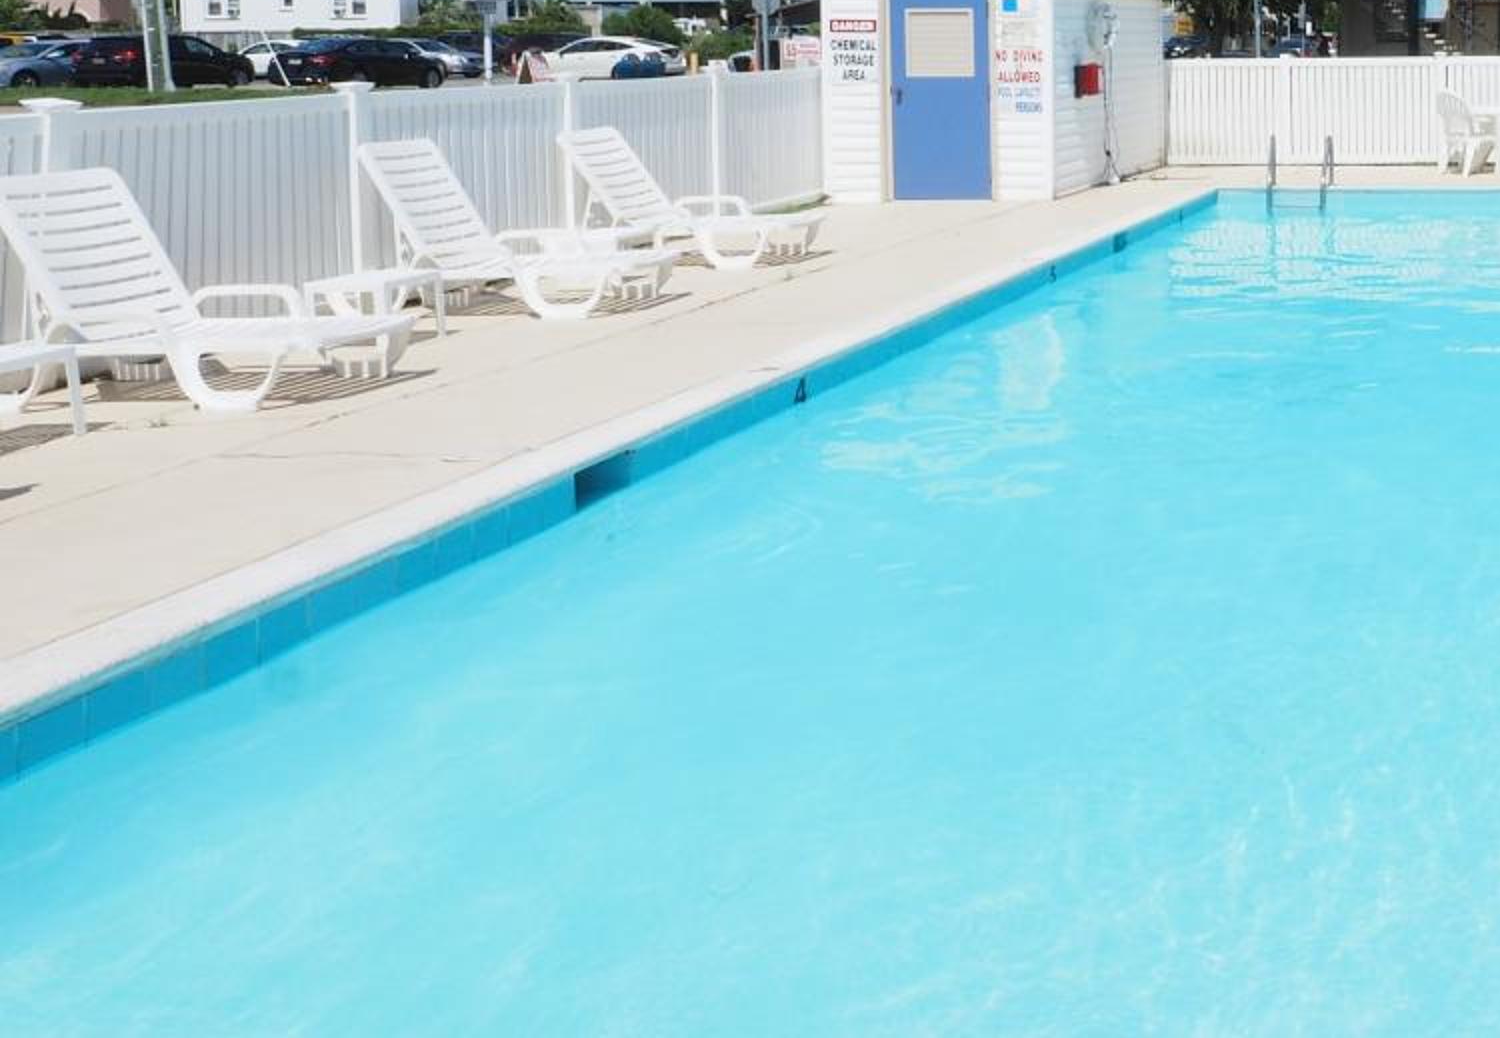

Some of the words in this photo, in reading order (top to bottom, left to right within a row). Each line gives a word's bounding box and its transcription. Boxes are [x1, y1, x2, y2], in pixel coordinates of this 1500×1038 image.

[830, 39, 876, 51] CHEMICAL
[833, 53, 874, 66] STORAGE
[995, 50, 1007, 63] NO
[1013, 50, 1043, 63] DIVING
[842, 69, 865, 81] AREA
[997, 70, 1041, 83] ALLOWED
